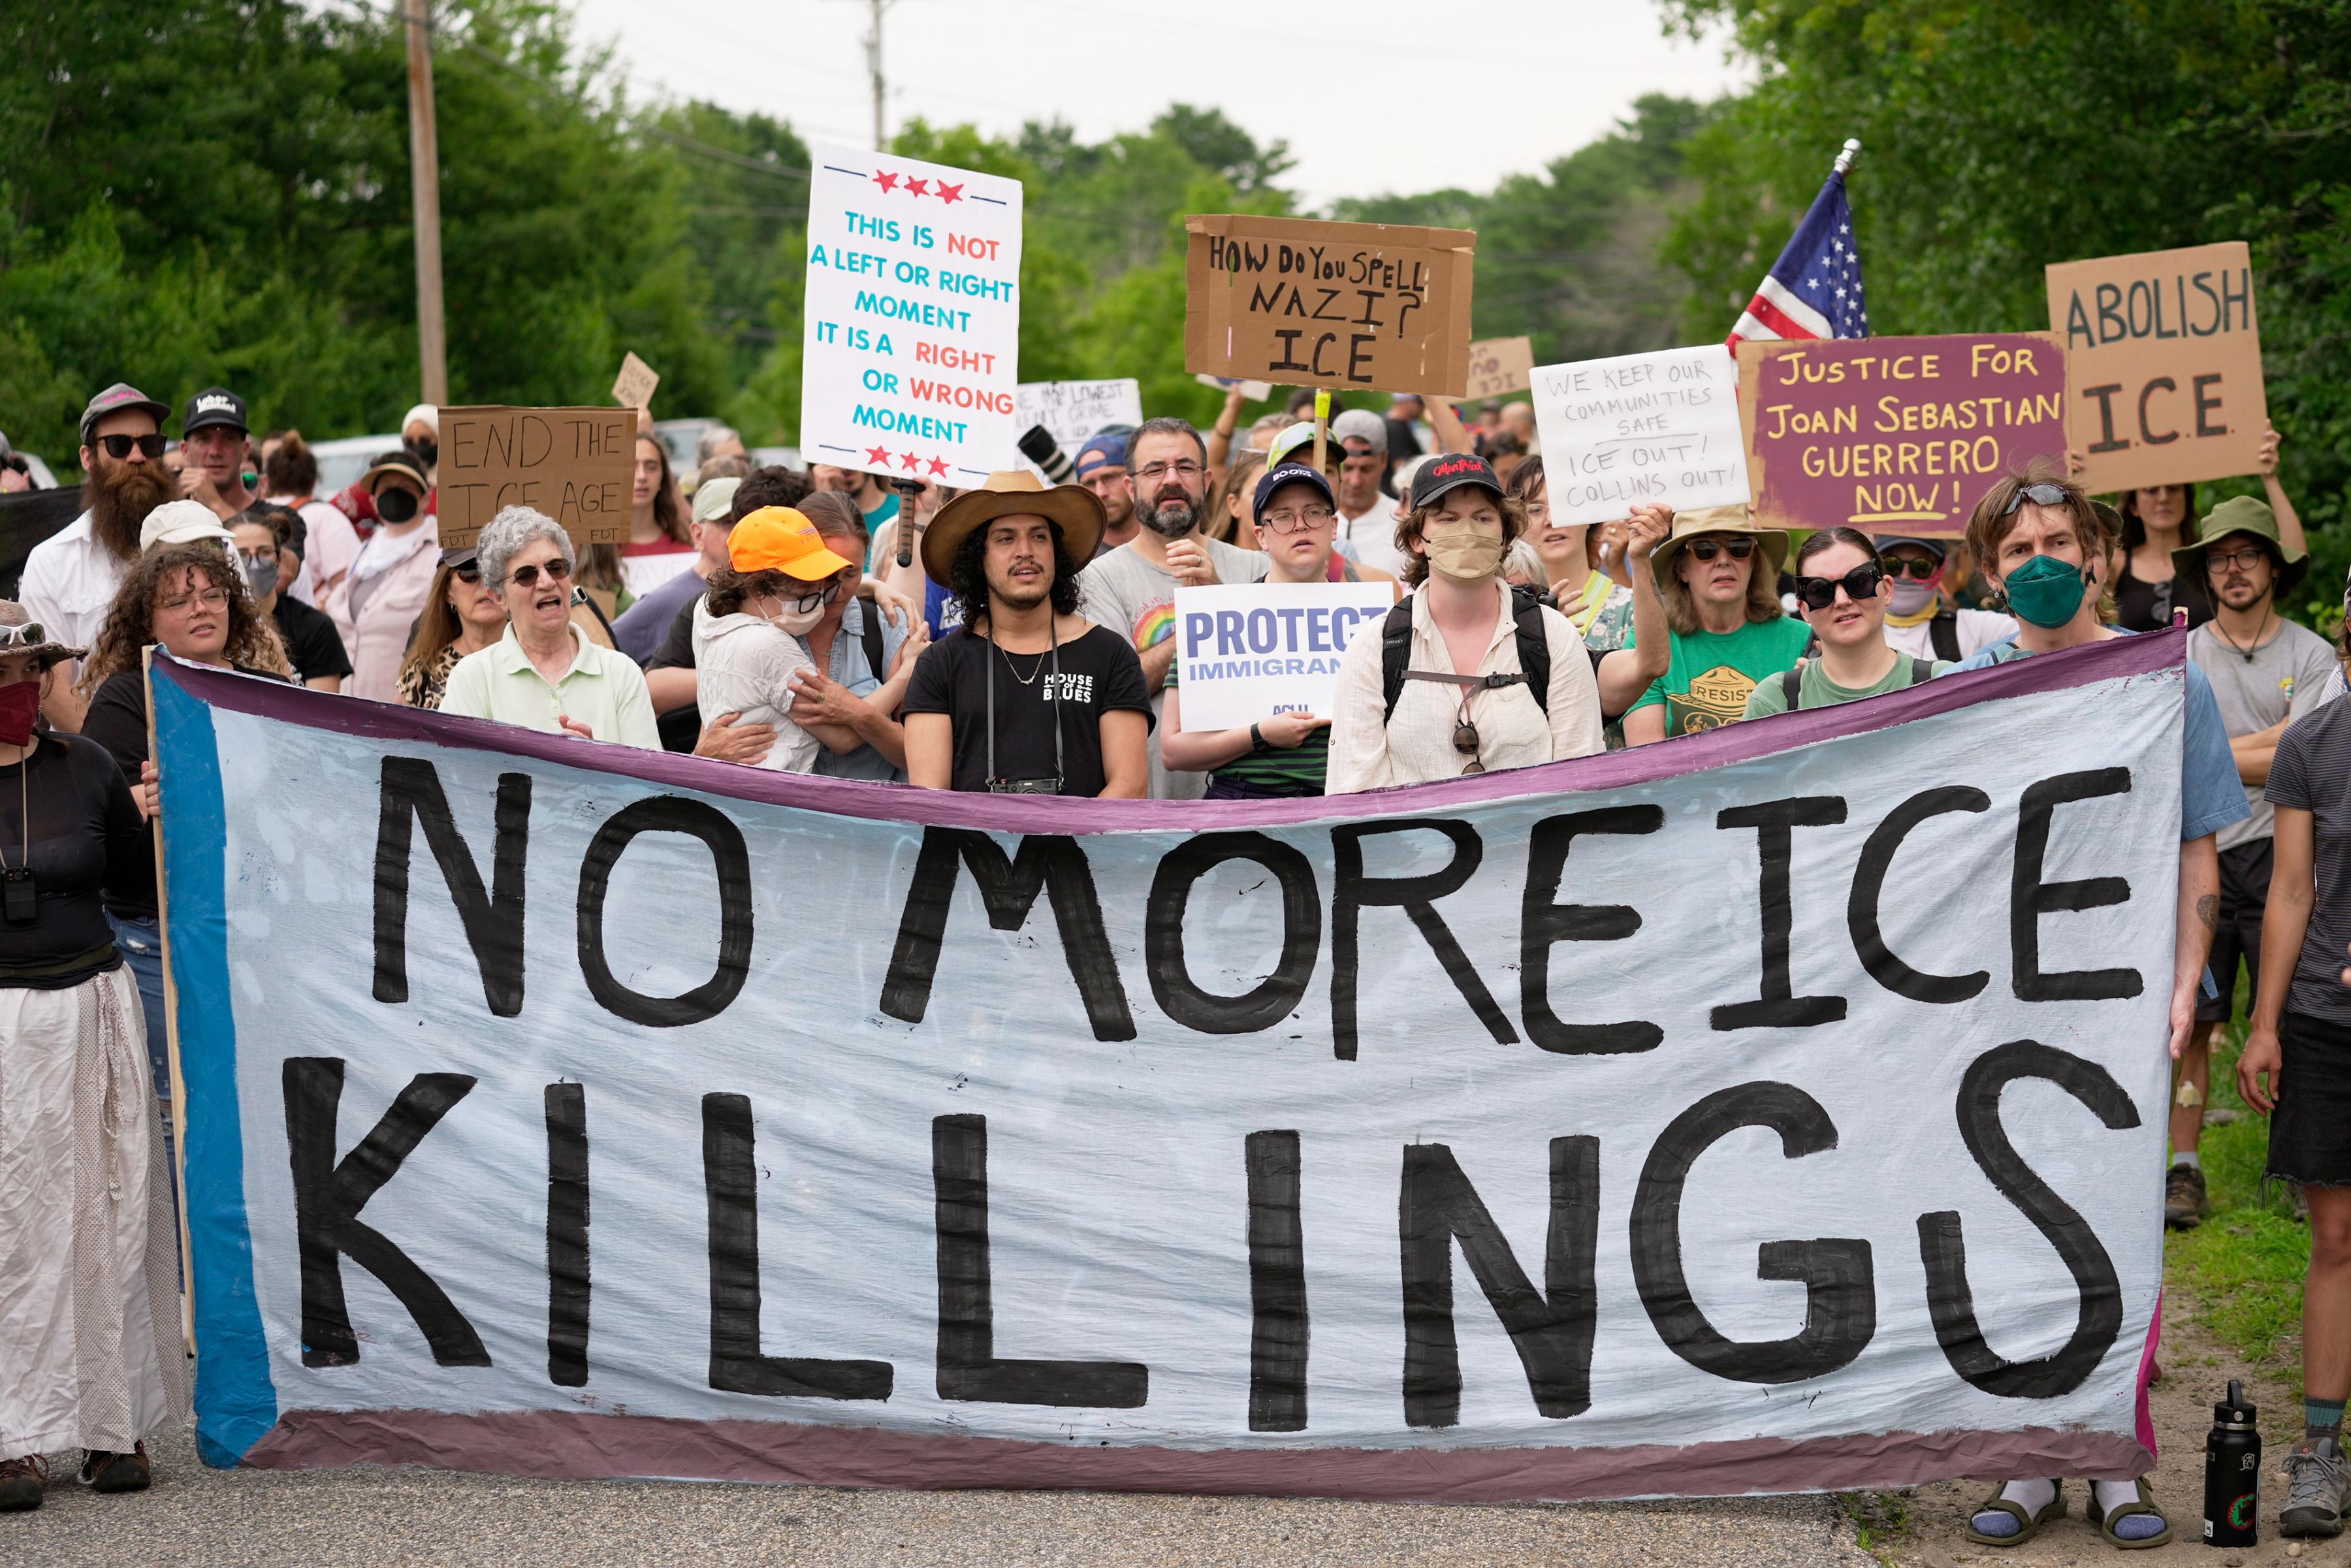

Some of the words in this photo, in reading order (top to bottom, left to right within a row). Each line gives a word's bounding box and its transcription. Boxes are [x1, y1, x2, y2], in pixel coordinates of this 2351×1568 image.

[844, 210, 901, 242] THIS
[913, 225, 934, 249] IS
[948, 232, 1000, 261] NOT
[810, 244, 828, 267] A
[835, 249, 887, 278] LEFT
[895, 261, 929, 287] OR
[939, 271, 1014, 303] RIGHT
[1210, 236, 1268, 273] HOW
[1279, 245, 1305, 274] DO
[1309, 246, 1345, 280] YOU
[1349, 251, 1425, 292] SPELL
[854, 291, 971, 332] MOMENT
[1249, 281, 1421, 338] NAZI?
[2067, 268, 2248, 349] ABOLISH
[817, 321, 839, 344] IT
[848, 327, 870, 351] IS
[876, 334, 893, 356] A
[916, 342, 996, 375] RIGHT
[1777, 351, 1940, 386] JUSTICE
[1972, 344, 2039, 377] FOR
[863, 369, 899, 395] OR
[910, 377, 1014, 415] WRONG
[1070, 383, 1123, 404] LOWEST
[1546, 370, 1592, 396] WE
[1604, 363, 1654, 391] KEEP
[1668, 359, 1714, 383] OUR
[852, 404, 968, 443] MOMENT
[1565, 387, 1713, 421] COMMUNITIES
[1616, 413, 1671, 436] SAFE
[1767, 404, 1857, 440] JOAN
[1874, 392, 2060, 433] SEBASTIAN
[2082, 373, 2237, 454] I.C.E.
[453, 415, 553, 469] END
[564, 420, 624, 459] THE
[1569, 448, 1622, 477] ICE
[1802, 435, 2000, 477] GUERRERO
[1567, 473, 1668, 507] COLLINS
[1681, 462, 1736, 488] OUT!
[1855, 480, 1961, 515] NOW!
[447, 481, 541, 533] ICE
[558, 481, 622, 525] AGE
[440, 533, 470, 549] FDT
[590, 527, 620, 541] FDT
[1045, 673, 1093, 686] HOUSE
[1189, 658, 1341, 682] IMMIGRAN
[1043, 688, 1091, 703] BUES
[372, 755, 754, 1028] NO
[879, 804, 1665, 1062] MORE
[1710, 766, 2144, 1032] ICE
[281, 1039, 2141, 1432] KILLINGS
